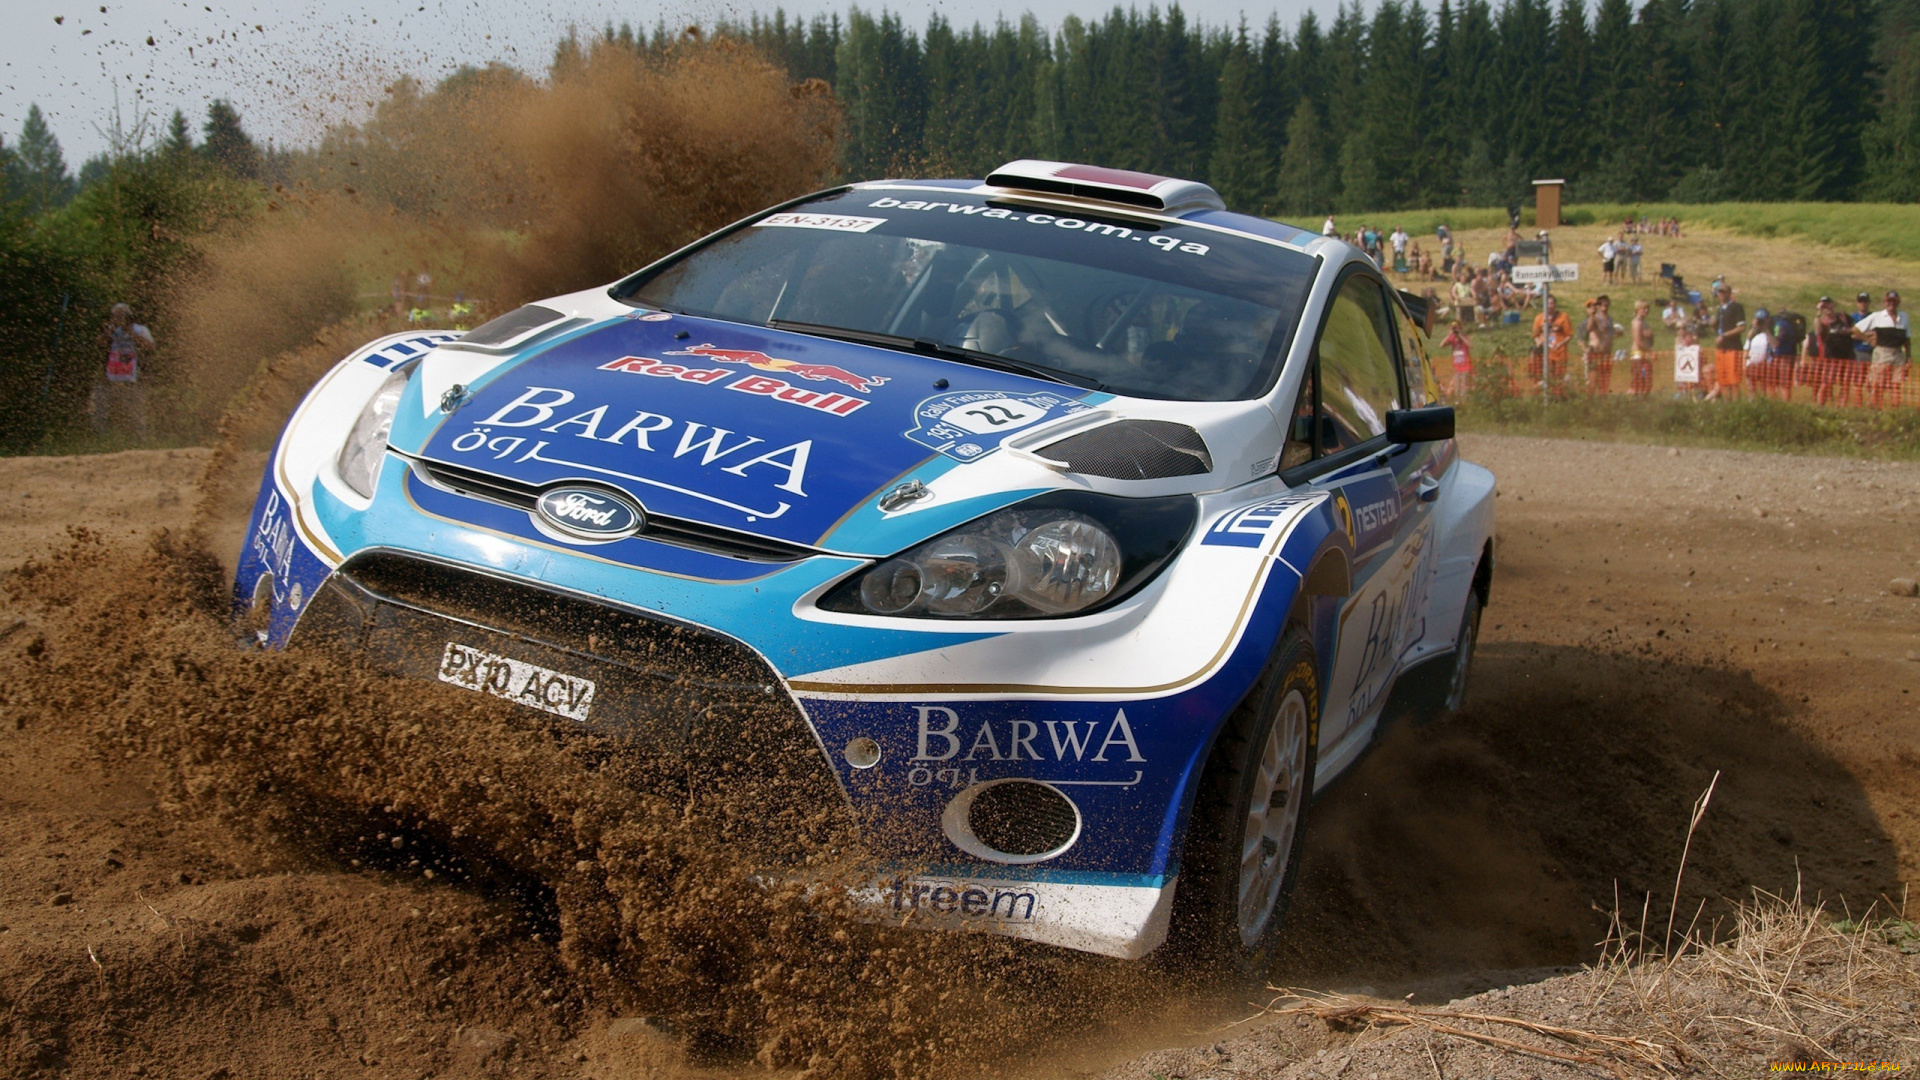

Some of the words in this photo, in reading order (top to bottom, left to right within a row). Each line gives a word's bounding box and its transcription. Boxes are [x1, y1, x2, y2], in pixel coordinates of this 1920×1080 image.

[766, 213, 875, 231] EN-3137
[868, 196, 1211, 257] barwa.com.qa
[597, 355, 736, 385] Red
[724, 373, 872, 418] Bull
[920, 401, 951, 419] Rally
[948, 391, 1009, 409] Finland
[965, 405, 1026, 426] 22
[926, 422, 965, 441] 1951
[555, 493, 618, 527] Ford
